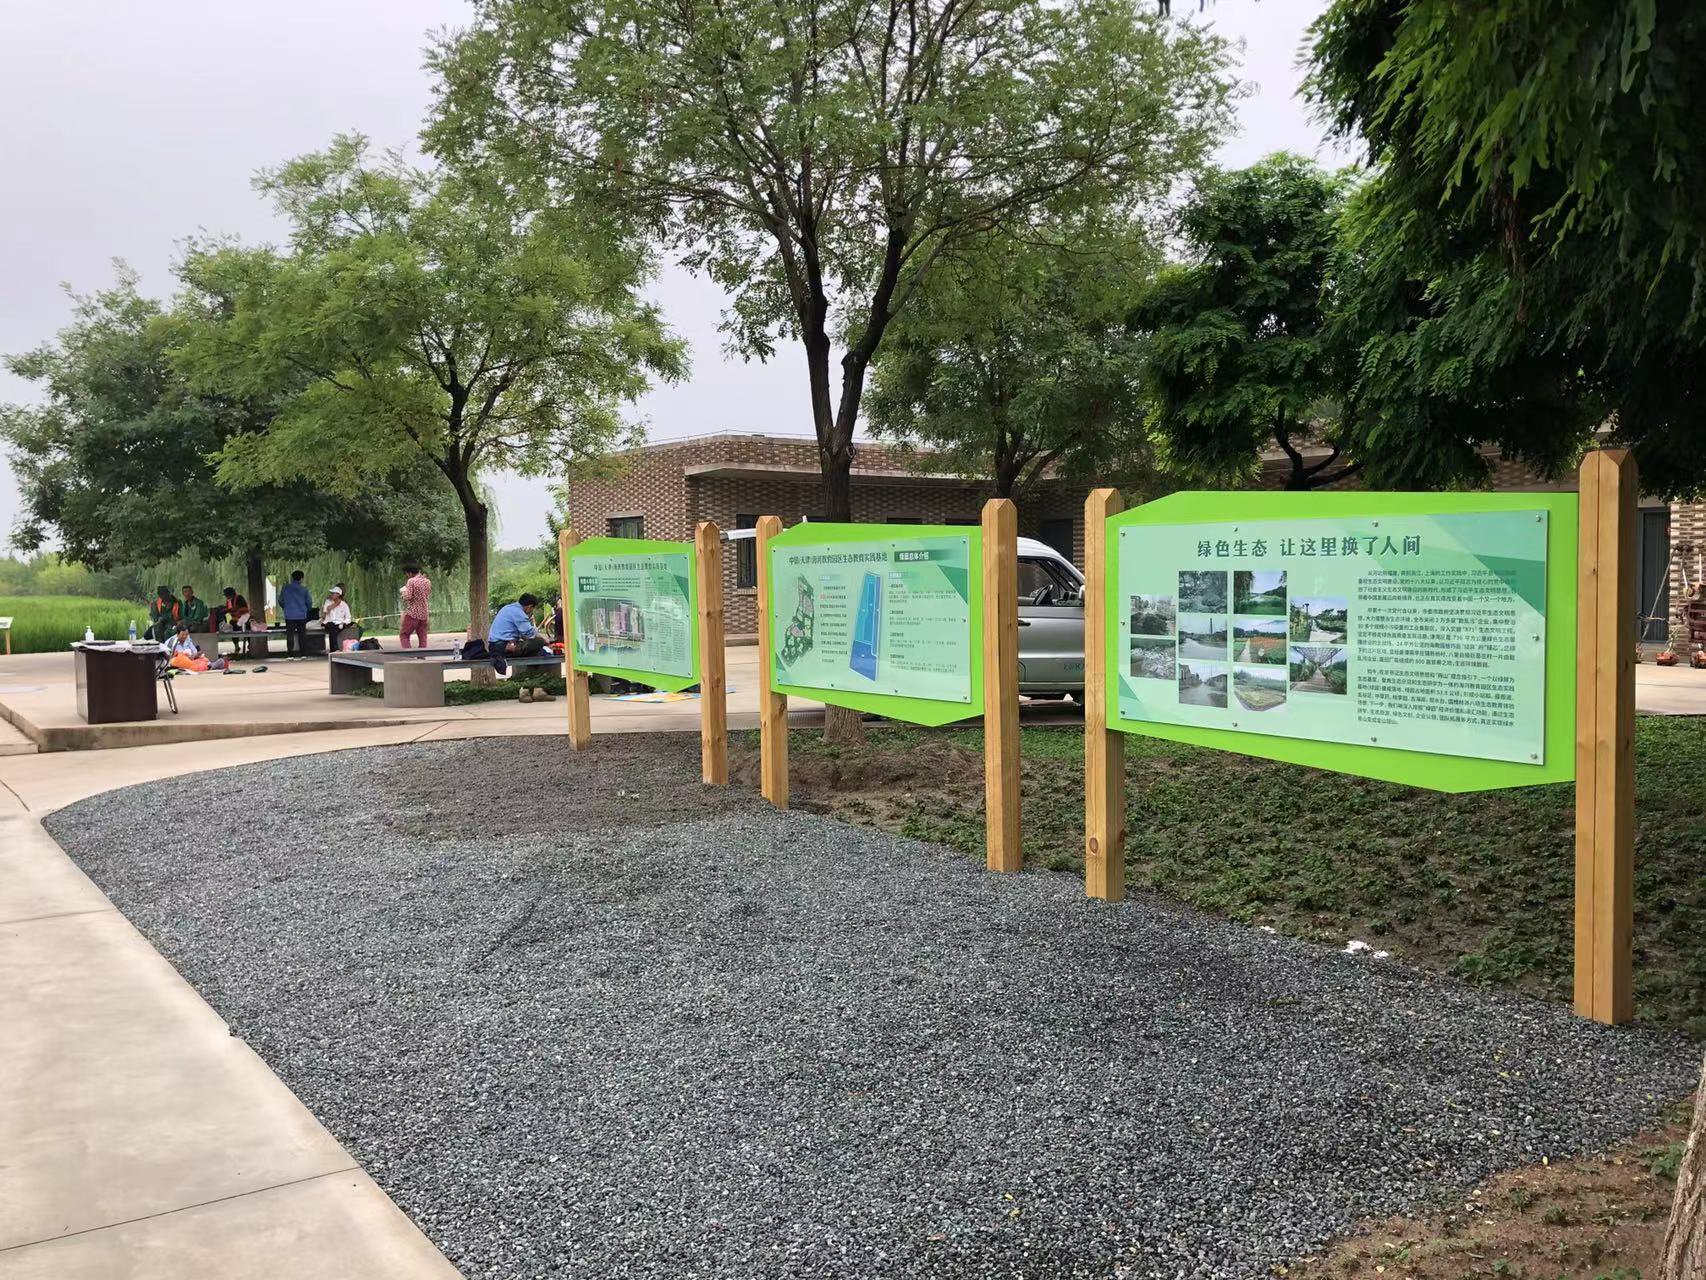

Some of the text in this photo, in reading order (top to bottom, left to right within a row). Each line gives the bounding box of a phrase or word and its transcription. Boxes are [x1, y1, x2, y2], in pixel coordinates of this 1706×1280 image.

[1198, 535, 1420, 557] 绿色生态 让这里换了人间
